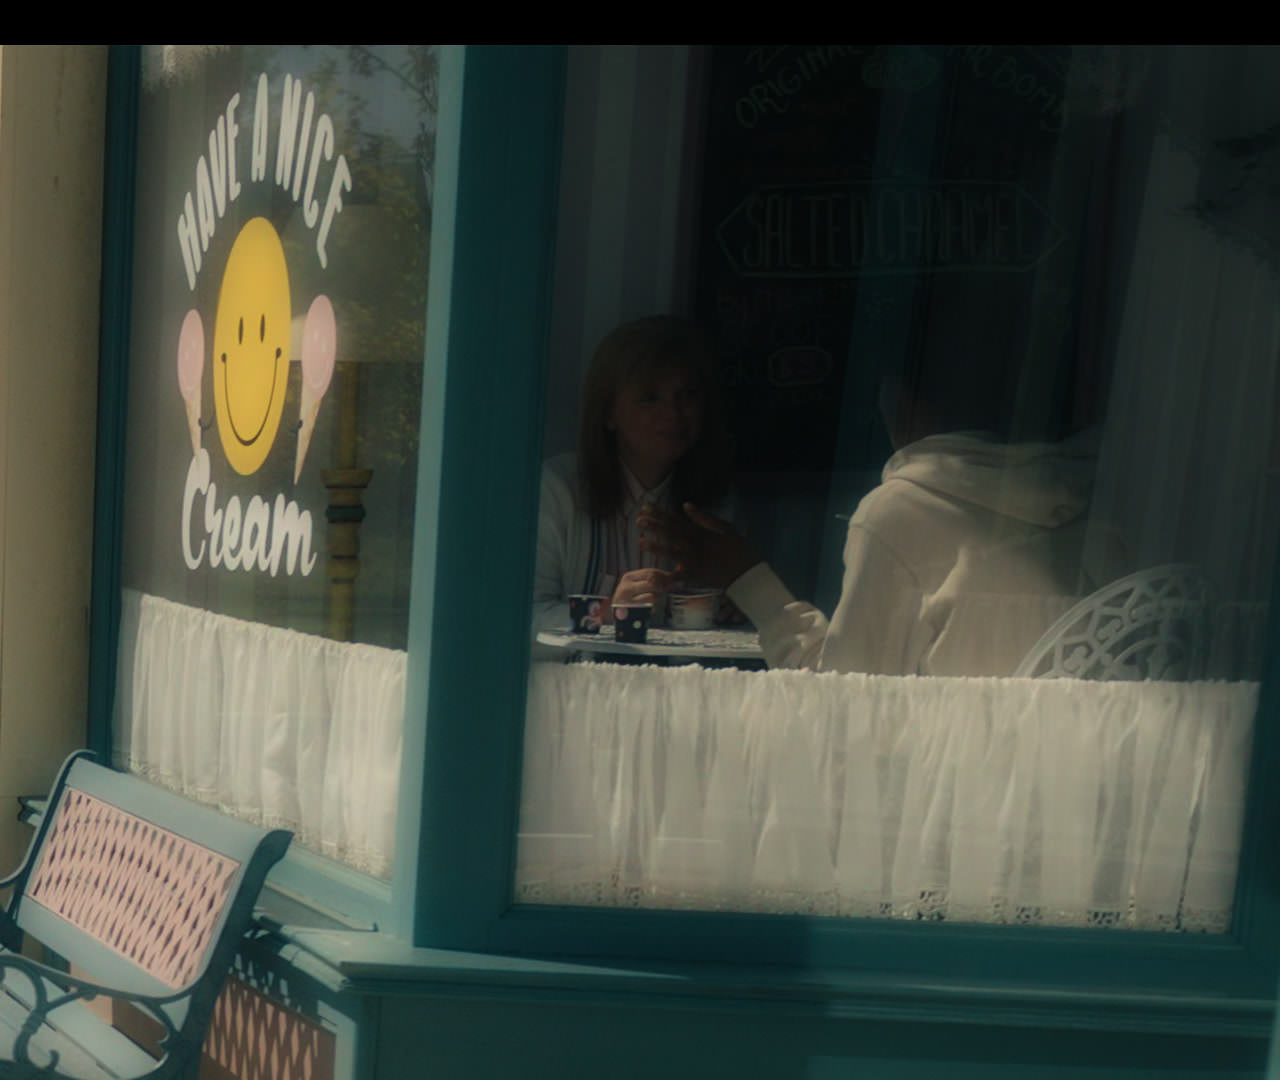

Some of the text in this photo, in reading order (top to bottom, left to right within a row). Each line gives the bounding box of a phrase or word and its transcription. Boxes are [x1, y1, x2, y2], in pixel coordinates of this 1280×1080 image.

[177, 73, 352, 291] HAVE A NICE
[742, 191, 870, 268] SALTED
[182, 448, 317, 577] Cream
